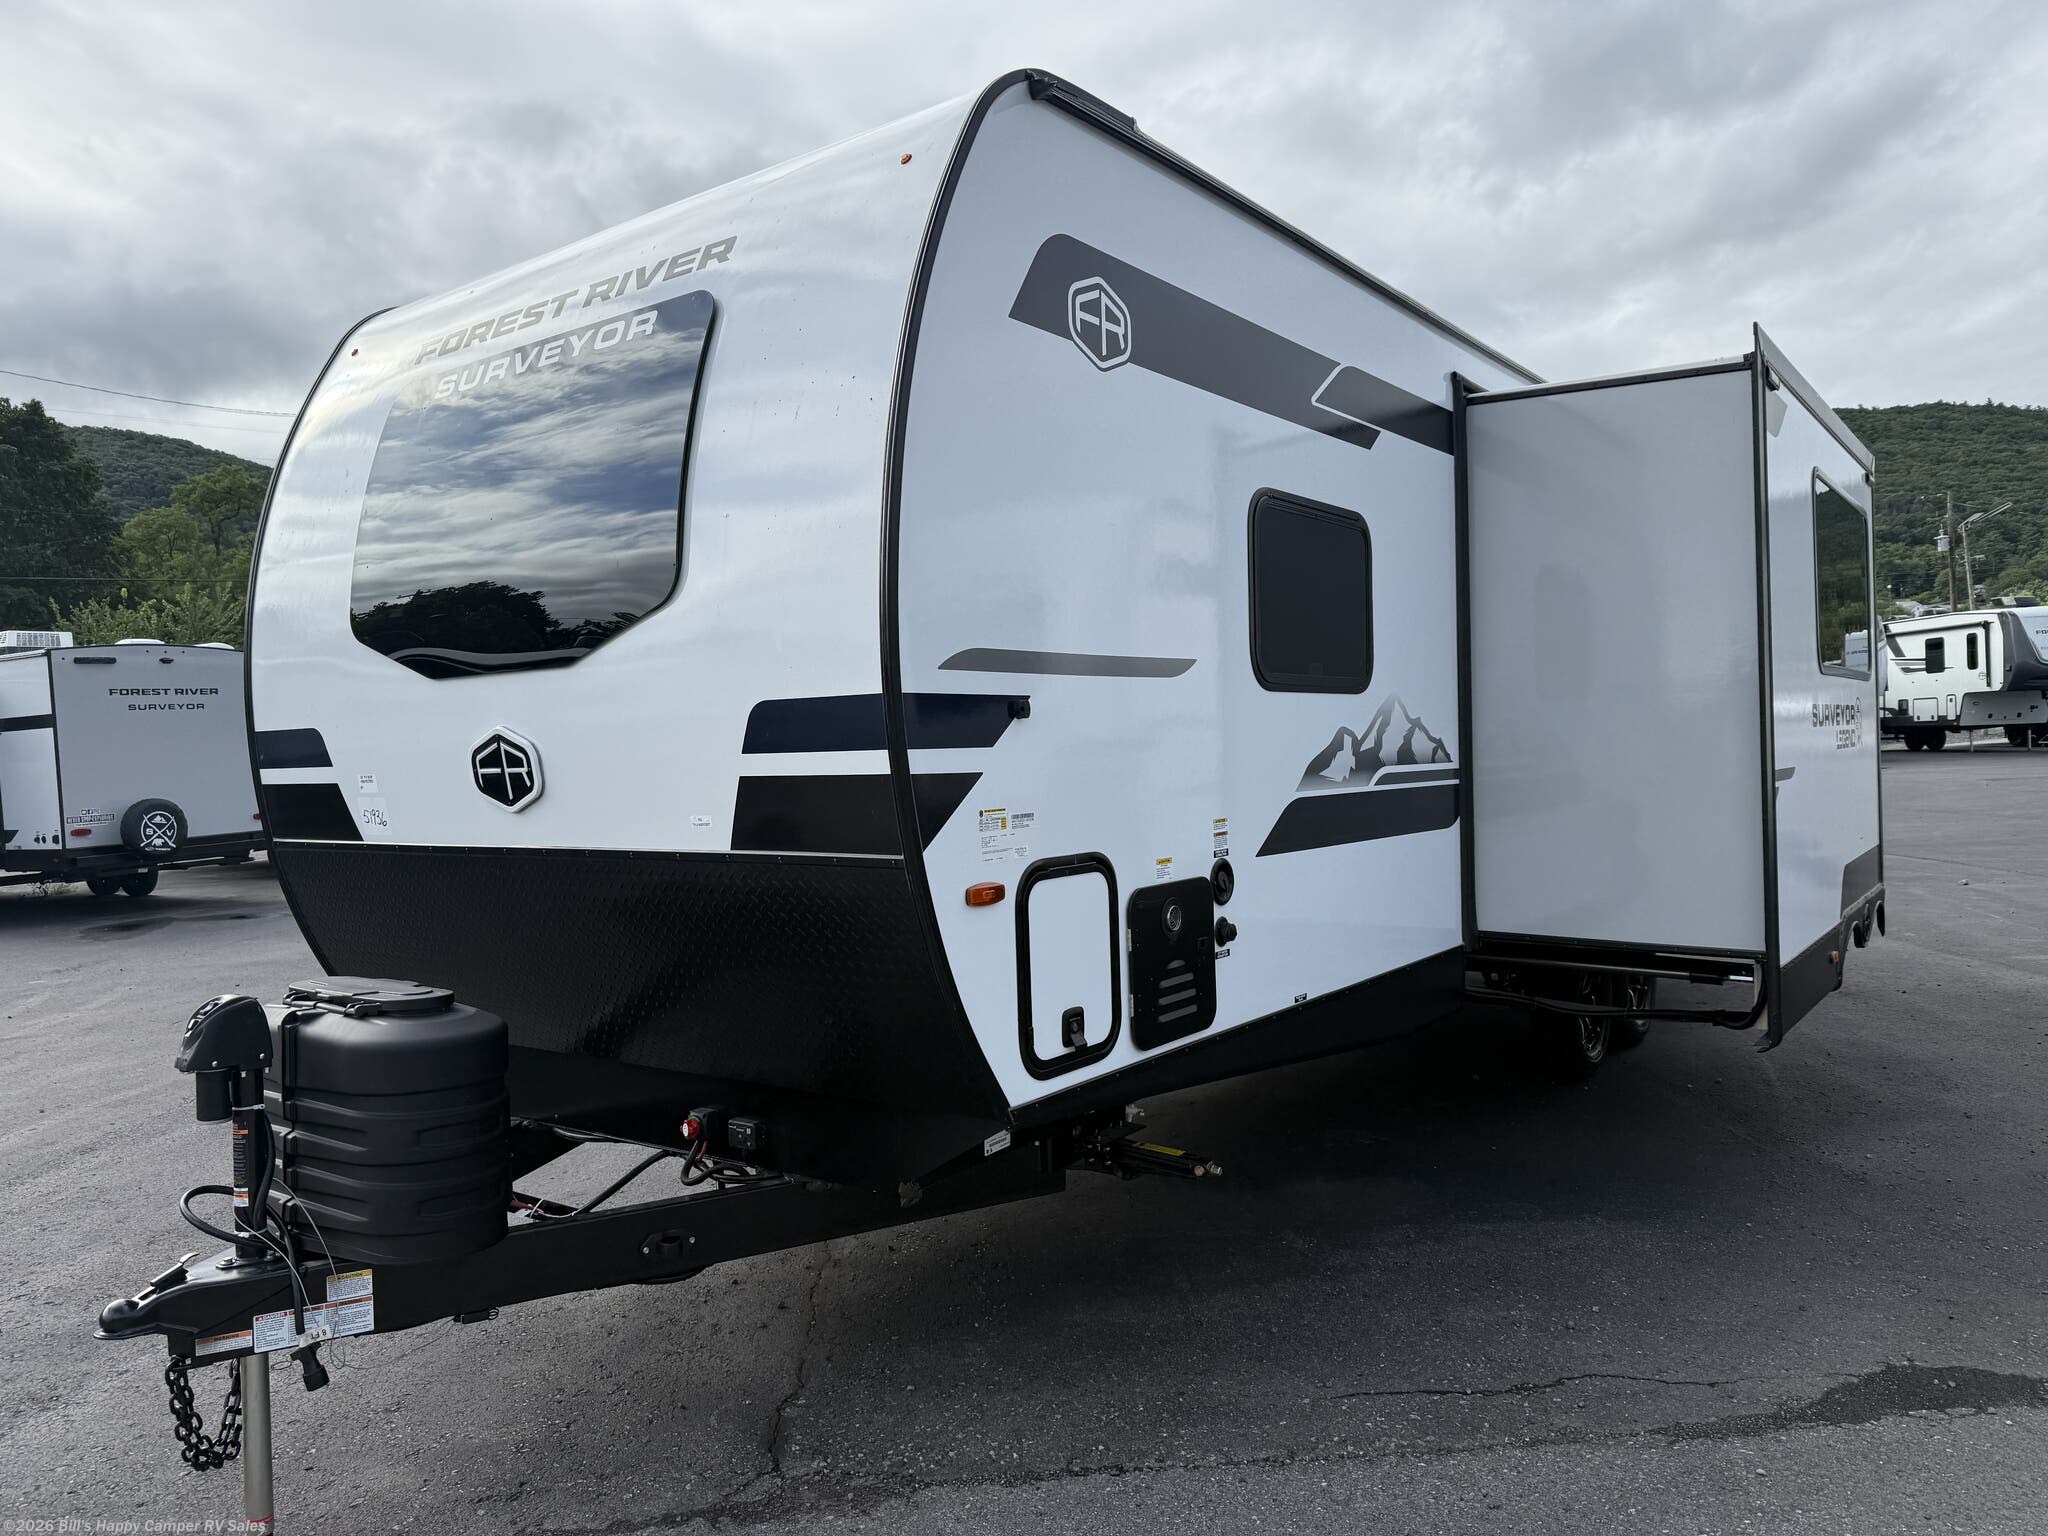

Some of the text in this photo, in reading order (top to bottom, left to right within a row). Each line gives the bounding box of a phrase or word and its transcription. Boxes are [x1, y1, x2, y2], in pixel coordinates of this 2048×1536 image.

[414, 235, 738, 366] FOREST RIVER
[435, 310, 658, 400] SURVEYOR
[108, 688, 171, 696] FOREST
[128, 703, 205, 711] SURVEYOR
[1812, 703, 1856, 728] SURVEYOR
